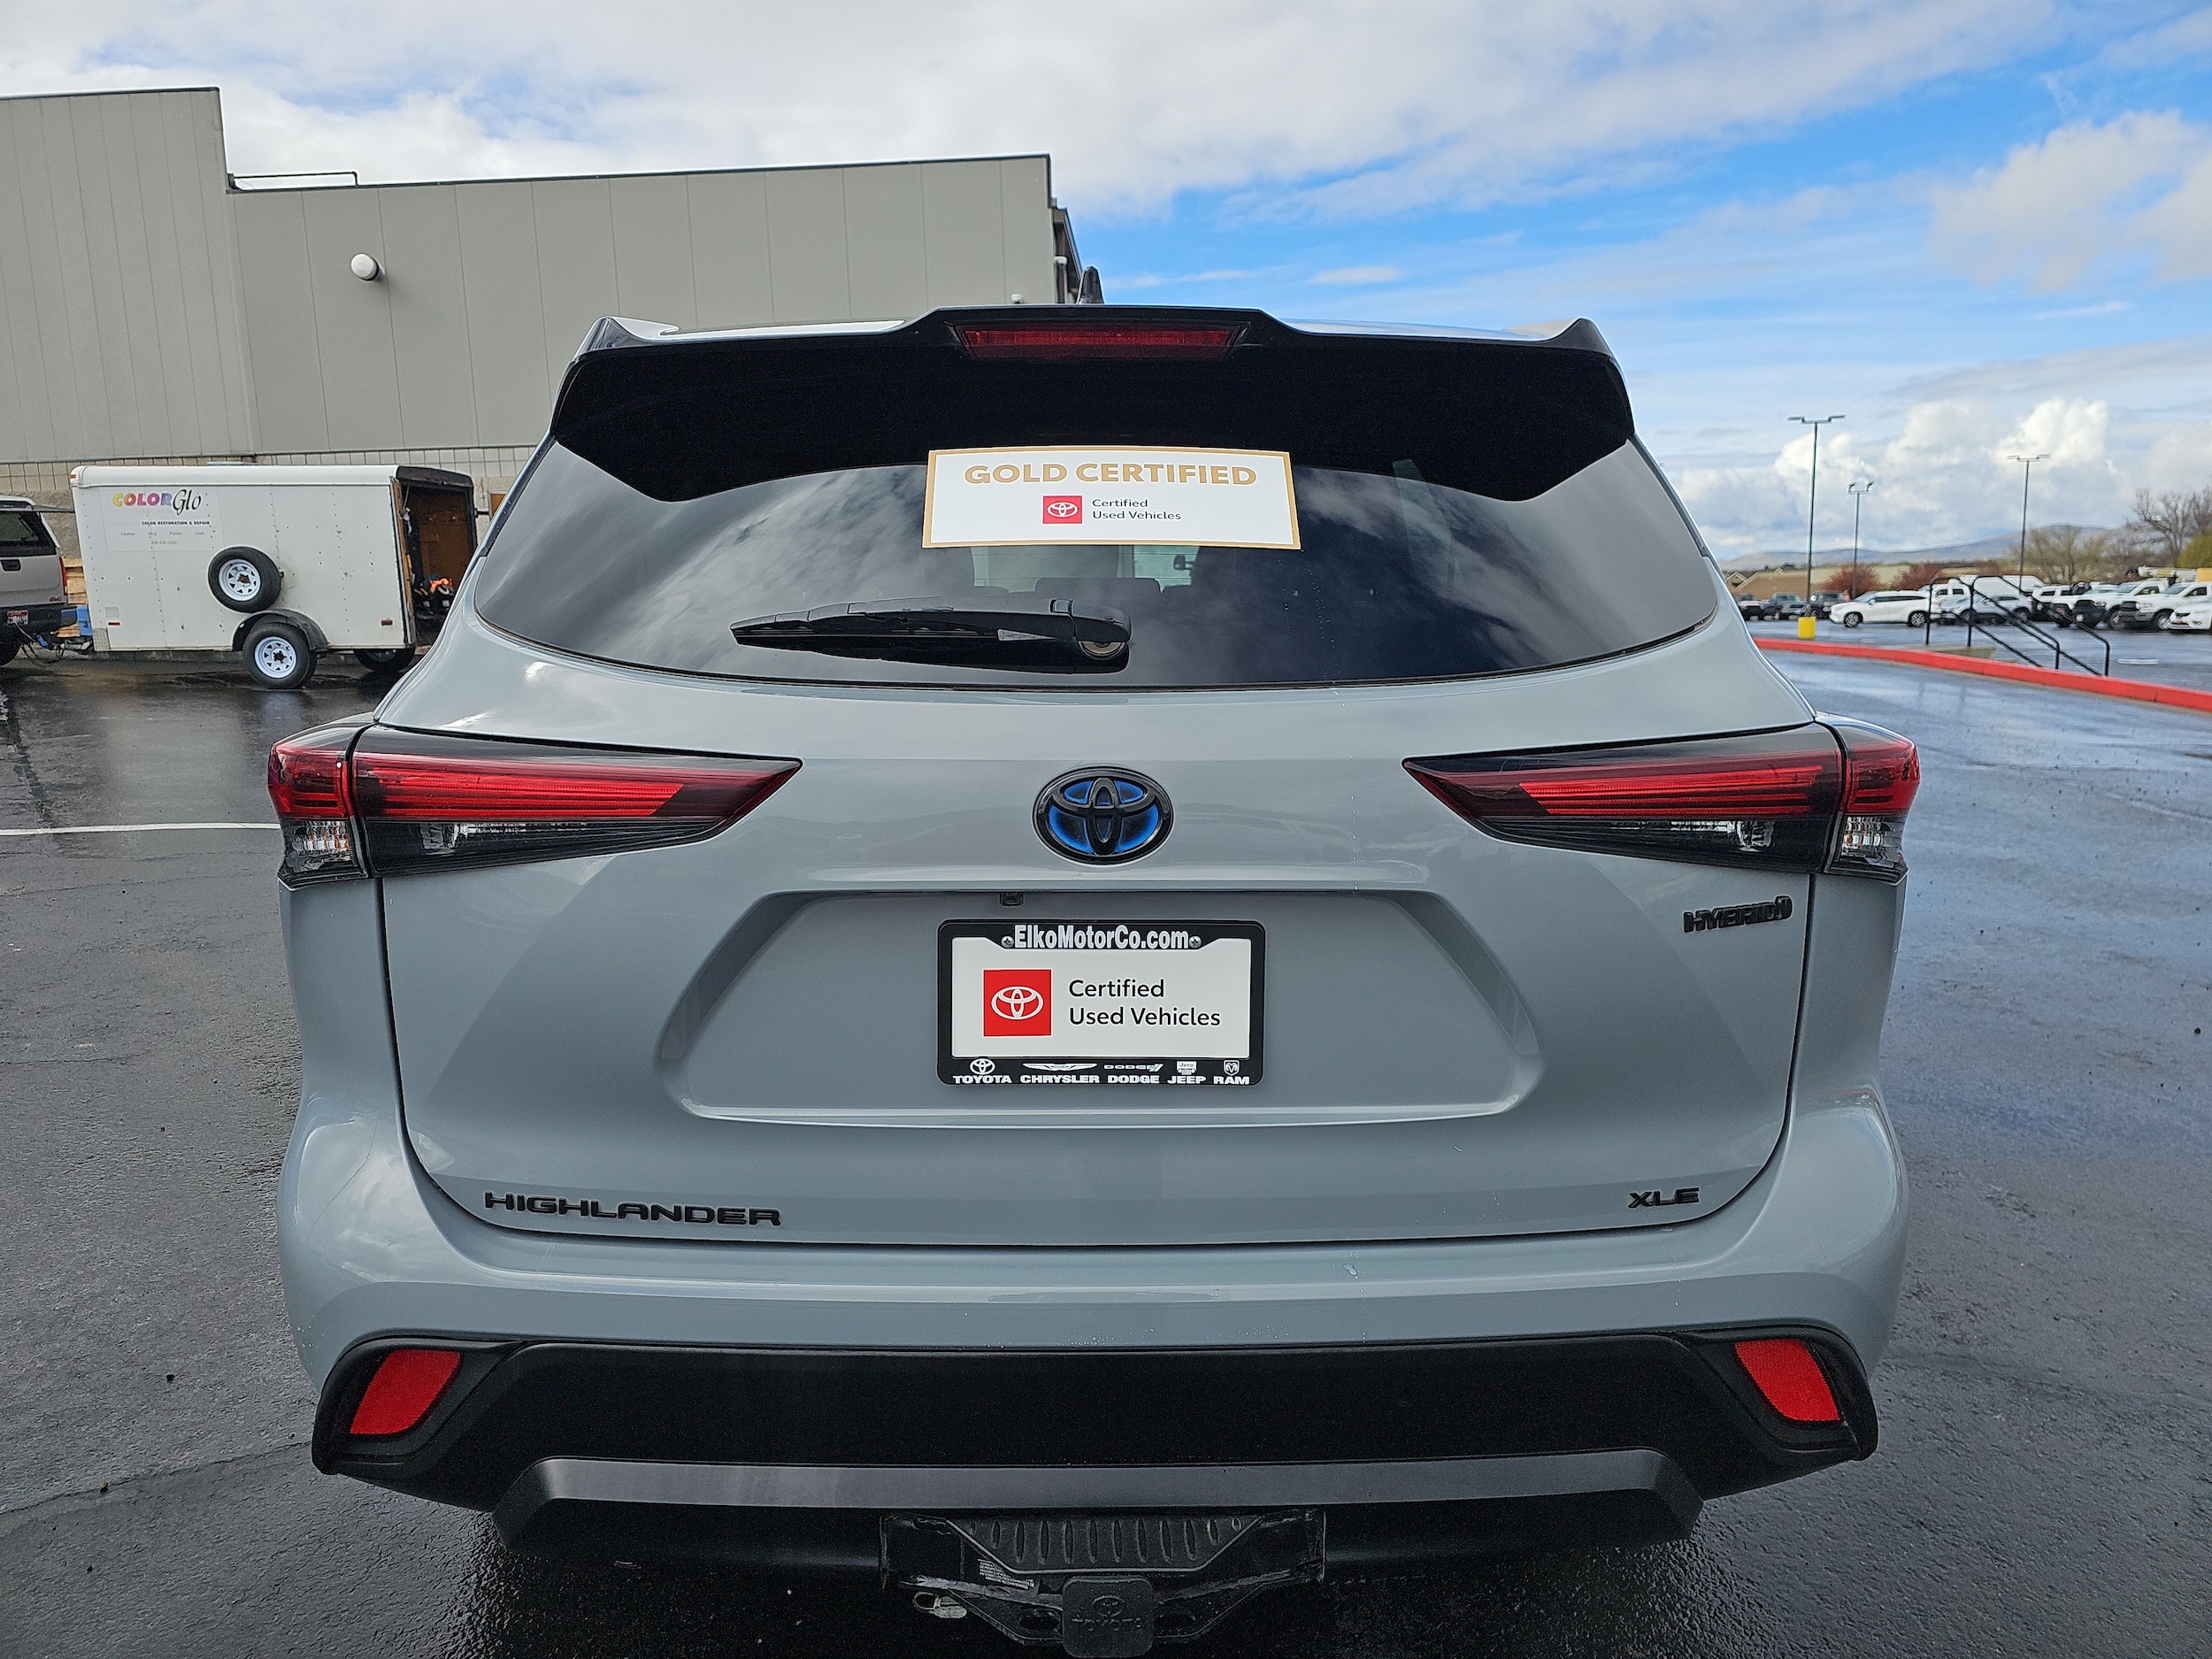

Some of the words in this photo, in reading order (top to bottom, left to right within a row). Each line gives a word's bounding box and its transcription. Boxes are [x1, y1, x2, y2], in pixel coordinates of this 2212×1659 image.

[964, 463, 1068, 484] GOLD
[1075, 463, 1257, 486] CERTIFIED
[1092, 498, 1148, 508] Certified
[1092, 510, 1126, 520] Used
[1128, 510, 1182, 520] Vehicles
[1683, 901, 1778, 933] HYBRID
[1014, 925, 1189, 949] ElkoMotorCo.com
[1068, 978, 1164, 997] Certified
[1069, 1007, 1125, 1025] Used
[1130, 1007, 1221, 1026] Vehicles
[953, 1074, 1012, 1084] TOYOTA
[1020, 1074, 1101, 1084] CHRYSLER
[1107, 1074, 1160, 1084] DODGE
[1167, 1075, 1207, 1085] JEEP
[1213, 1075, 1250, 1086] RAM
[1628, 1187, 1700, 1208] XLE
[484, 1191, 781, 1226] HIGHLANDER
